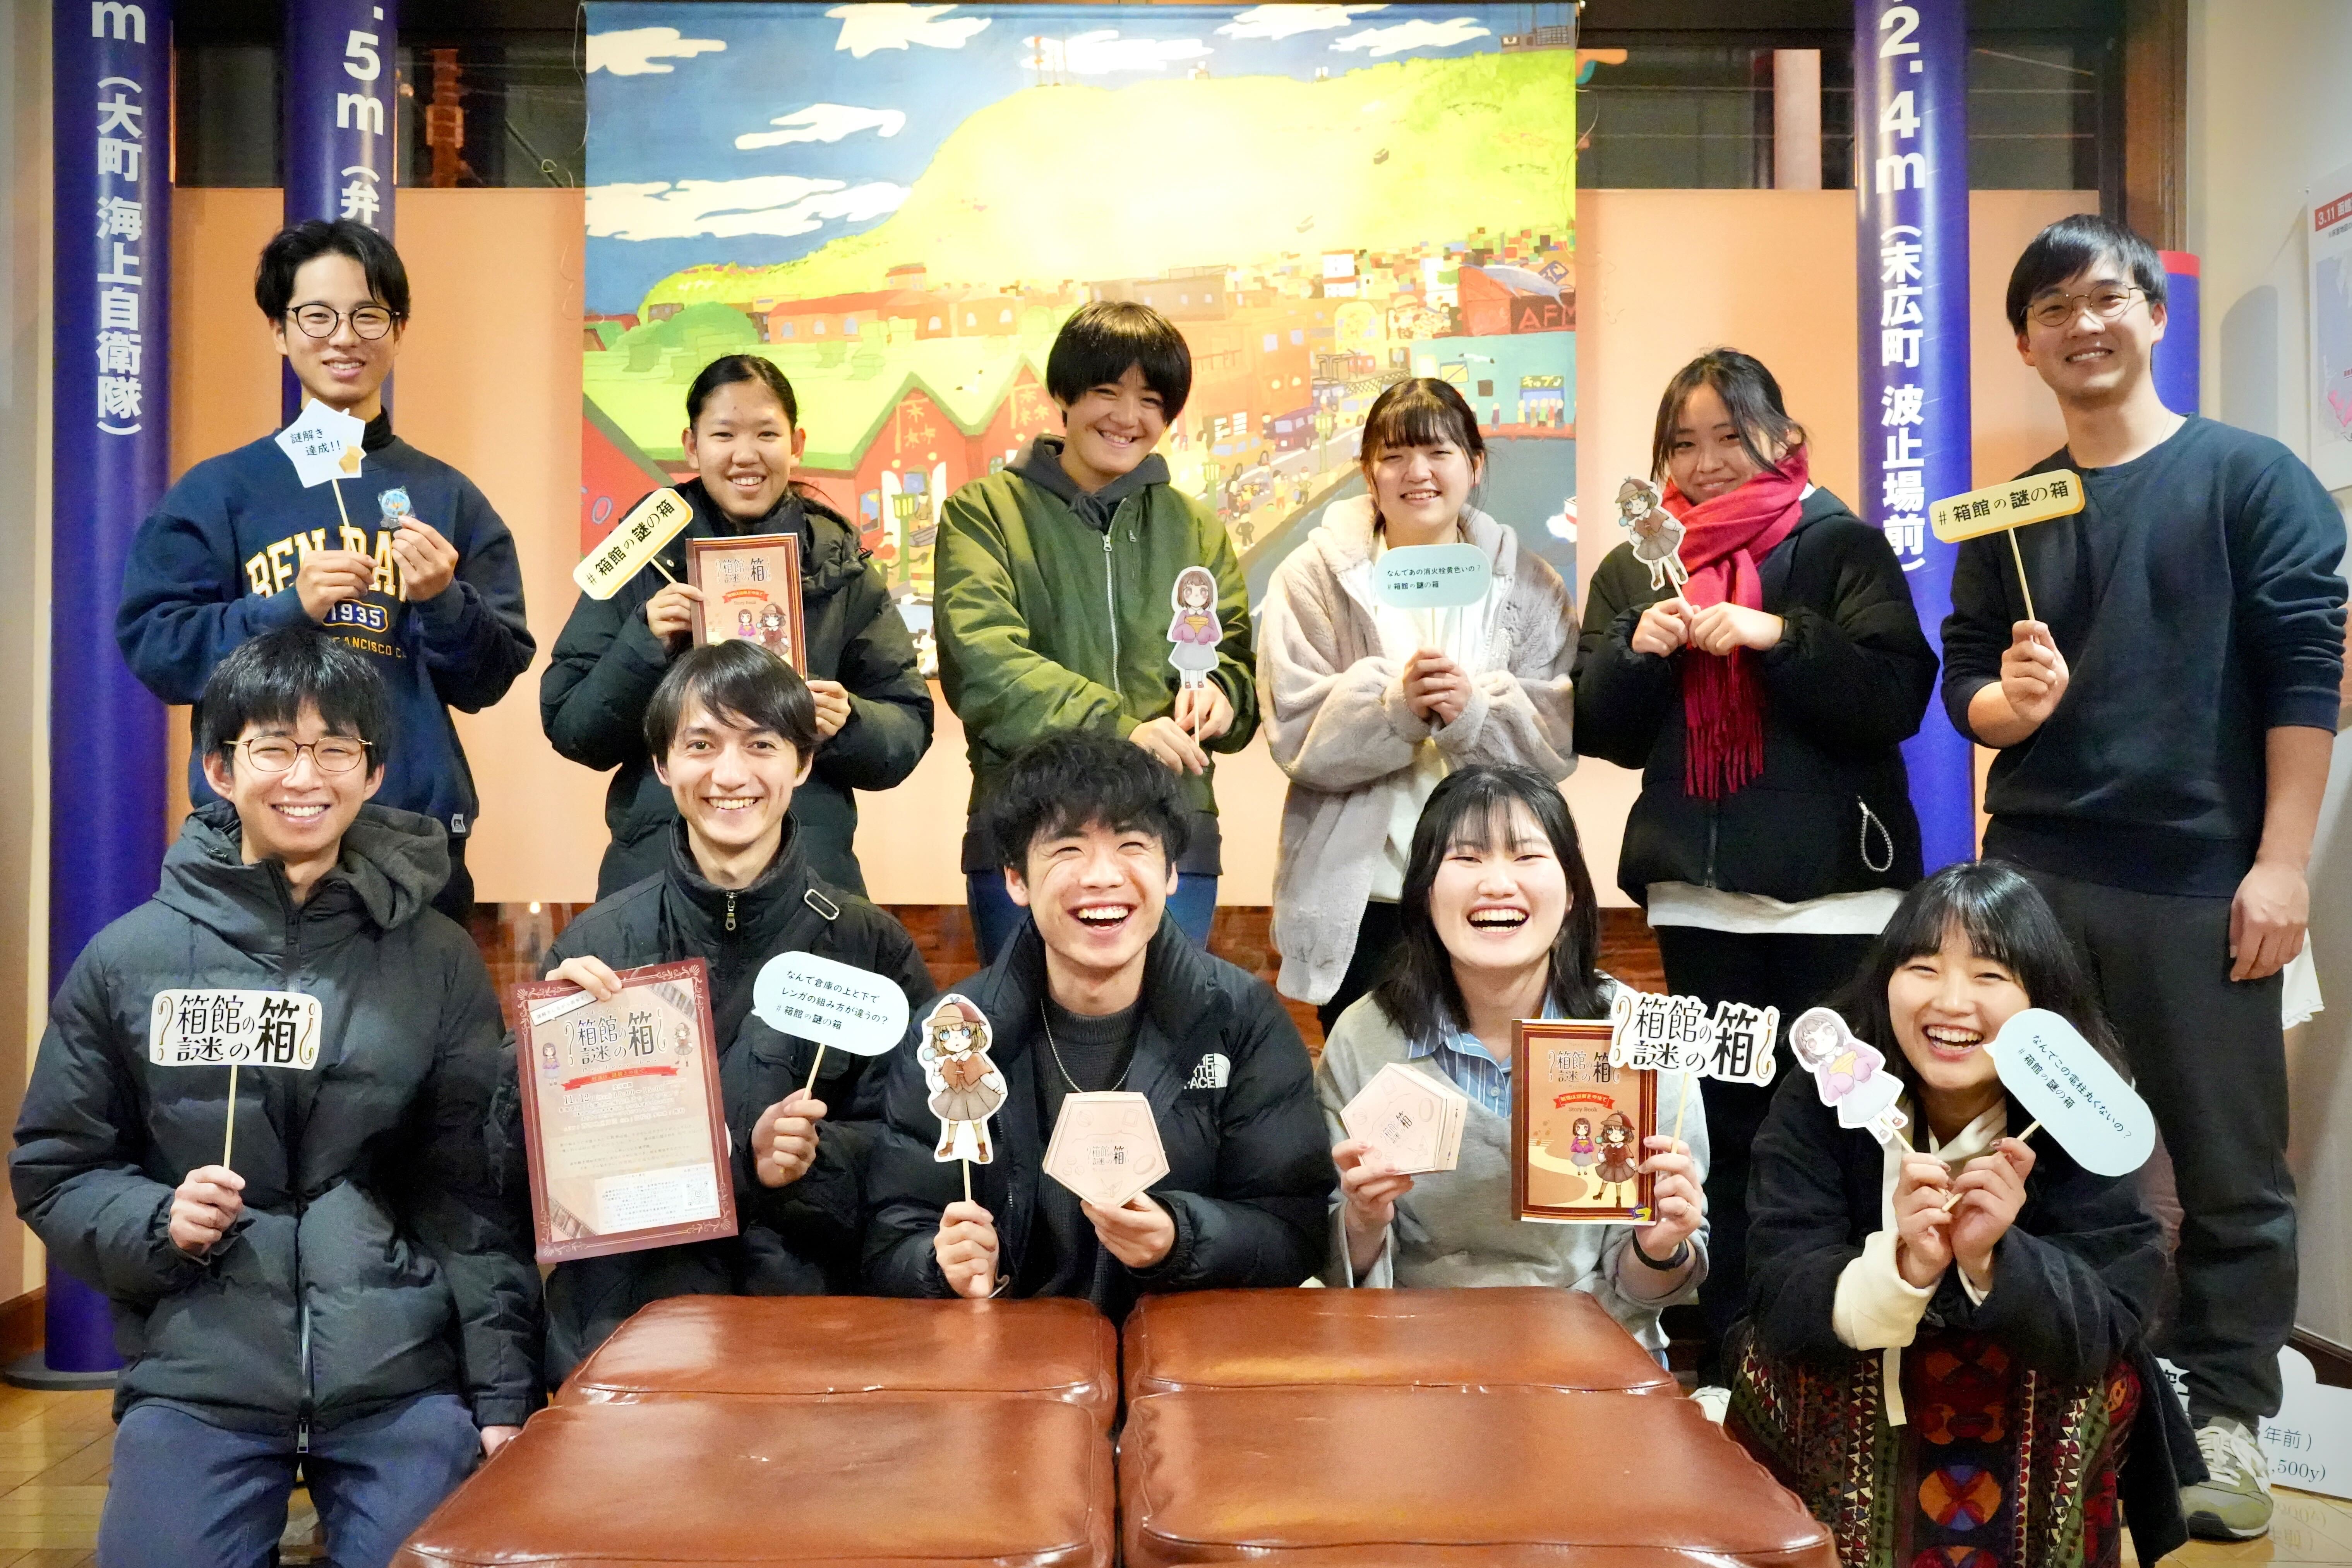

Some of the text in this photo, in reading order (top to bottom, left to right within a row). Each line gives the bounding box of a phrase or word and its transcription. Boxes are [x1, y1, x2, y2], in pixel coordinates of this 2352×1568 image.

[290, 428, 323, 444] 謎解き
[330, 603, 381, 628] 1935
[787, 970, 880, 1004] なんで倉庫の上と下で
